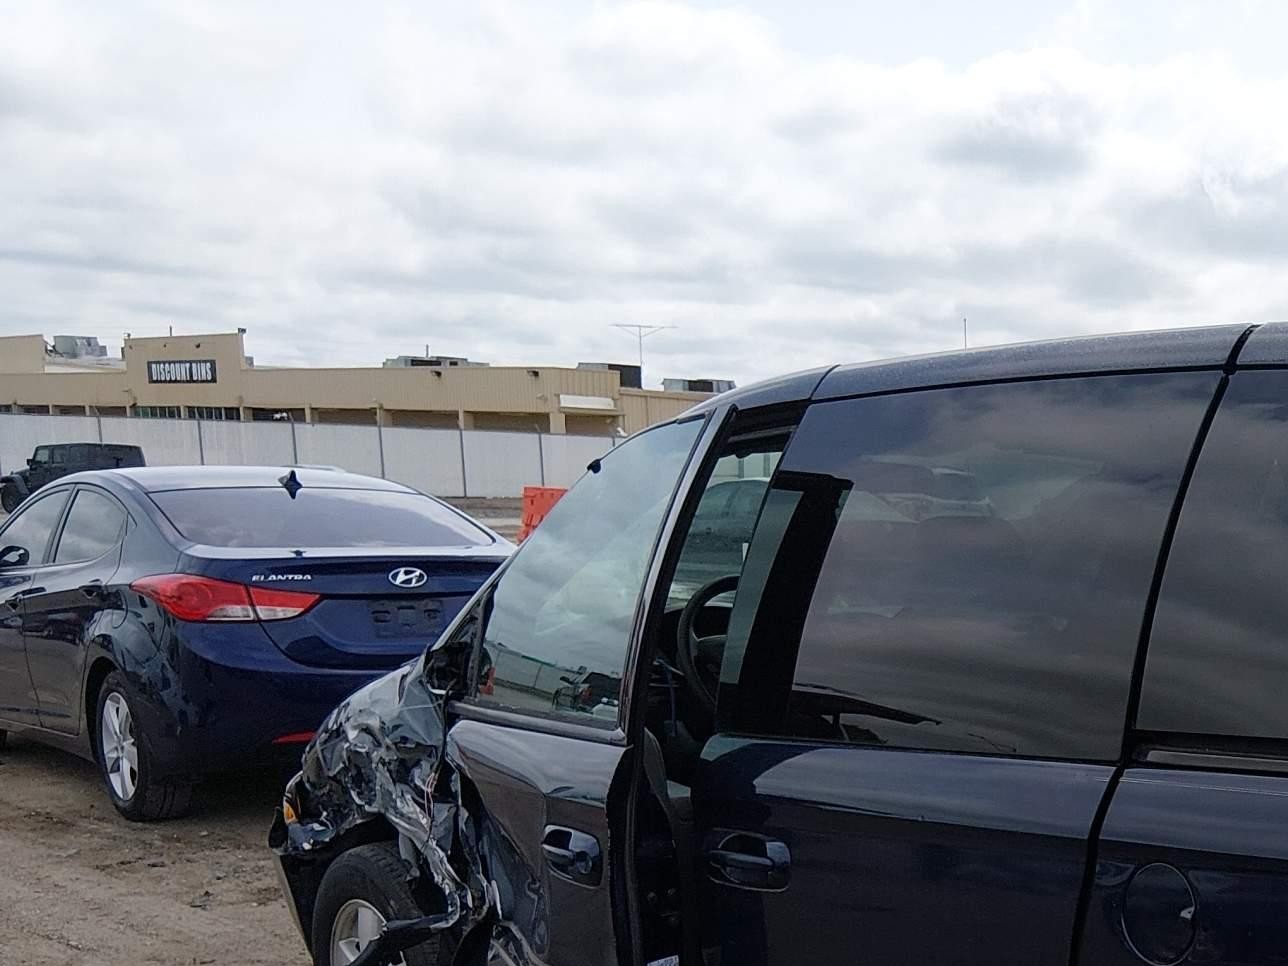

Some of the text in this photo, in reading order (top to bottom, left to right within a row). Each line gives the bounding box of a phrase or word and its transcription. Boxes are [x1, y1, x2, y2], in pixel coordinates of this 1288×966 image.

[151, 362, 212, 381] DISCOUNT BINS
[251, 573, 312, 582] ELANTRA
